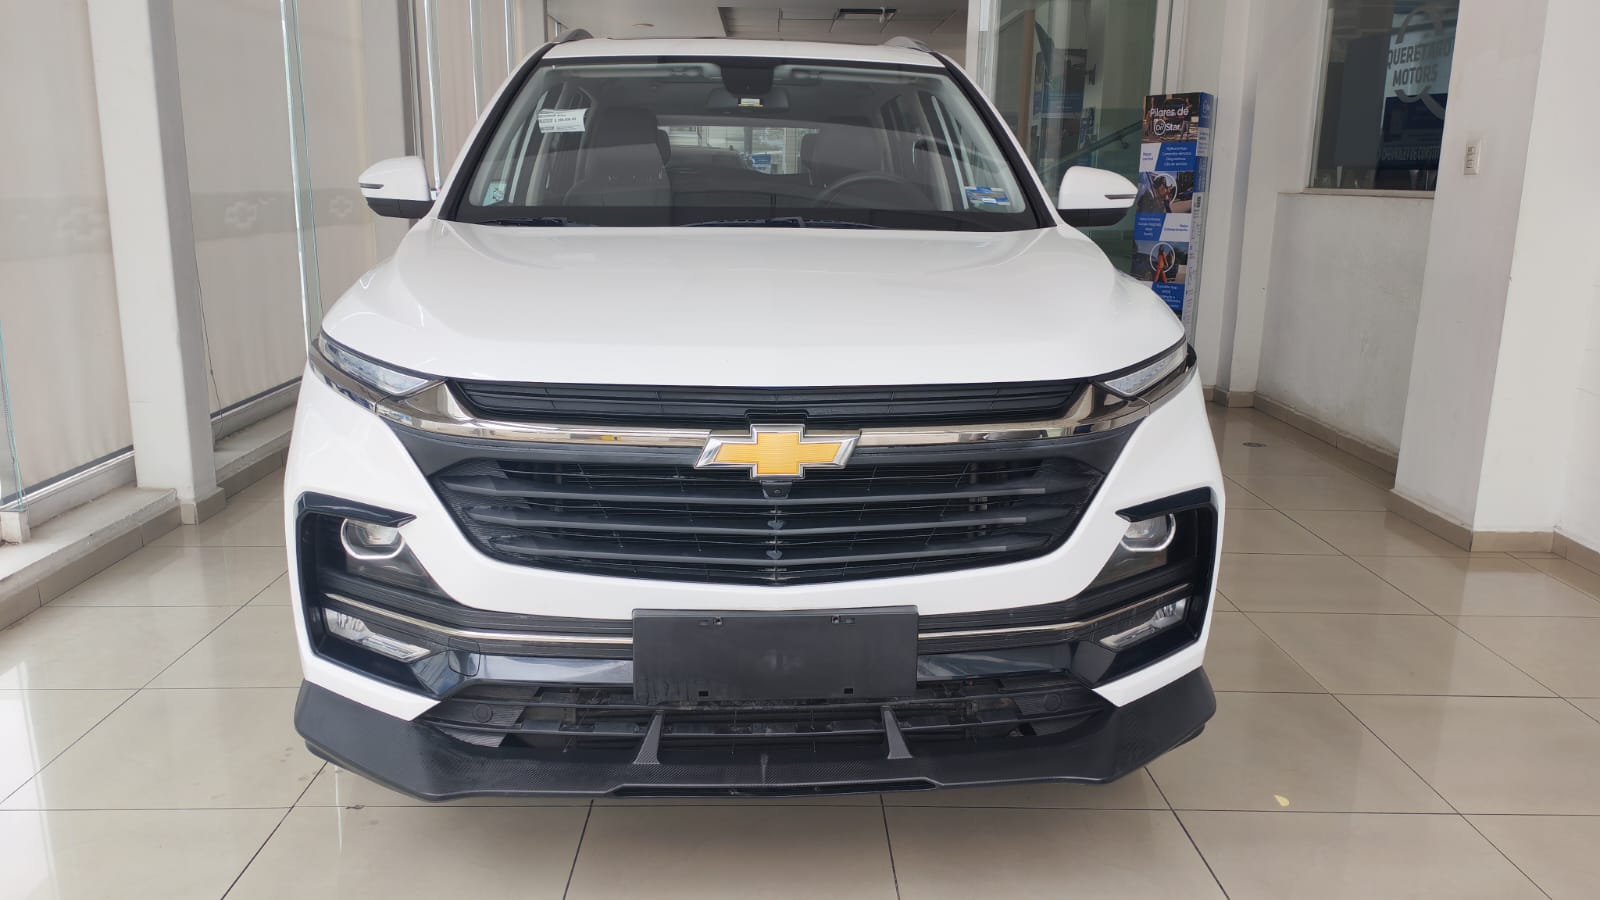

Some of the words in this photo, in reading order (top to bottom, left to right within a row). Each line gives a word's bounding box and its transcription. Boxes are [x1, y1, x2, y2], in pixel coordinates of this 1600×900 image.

[1392, 63, 1438, 87] MOTORS
[1150, 107, 1176, 116] Pilares
[1177, 106, 1189, 116] de
